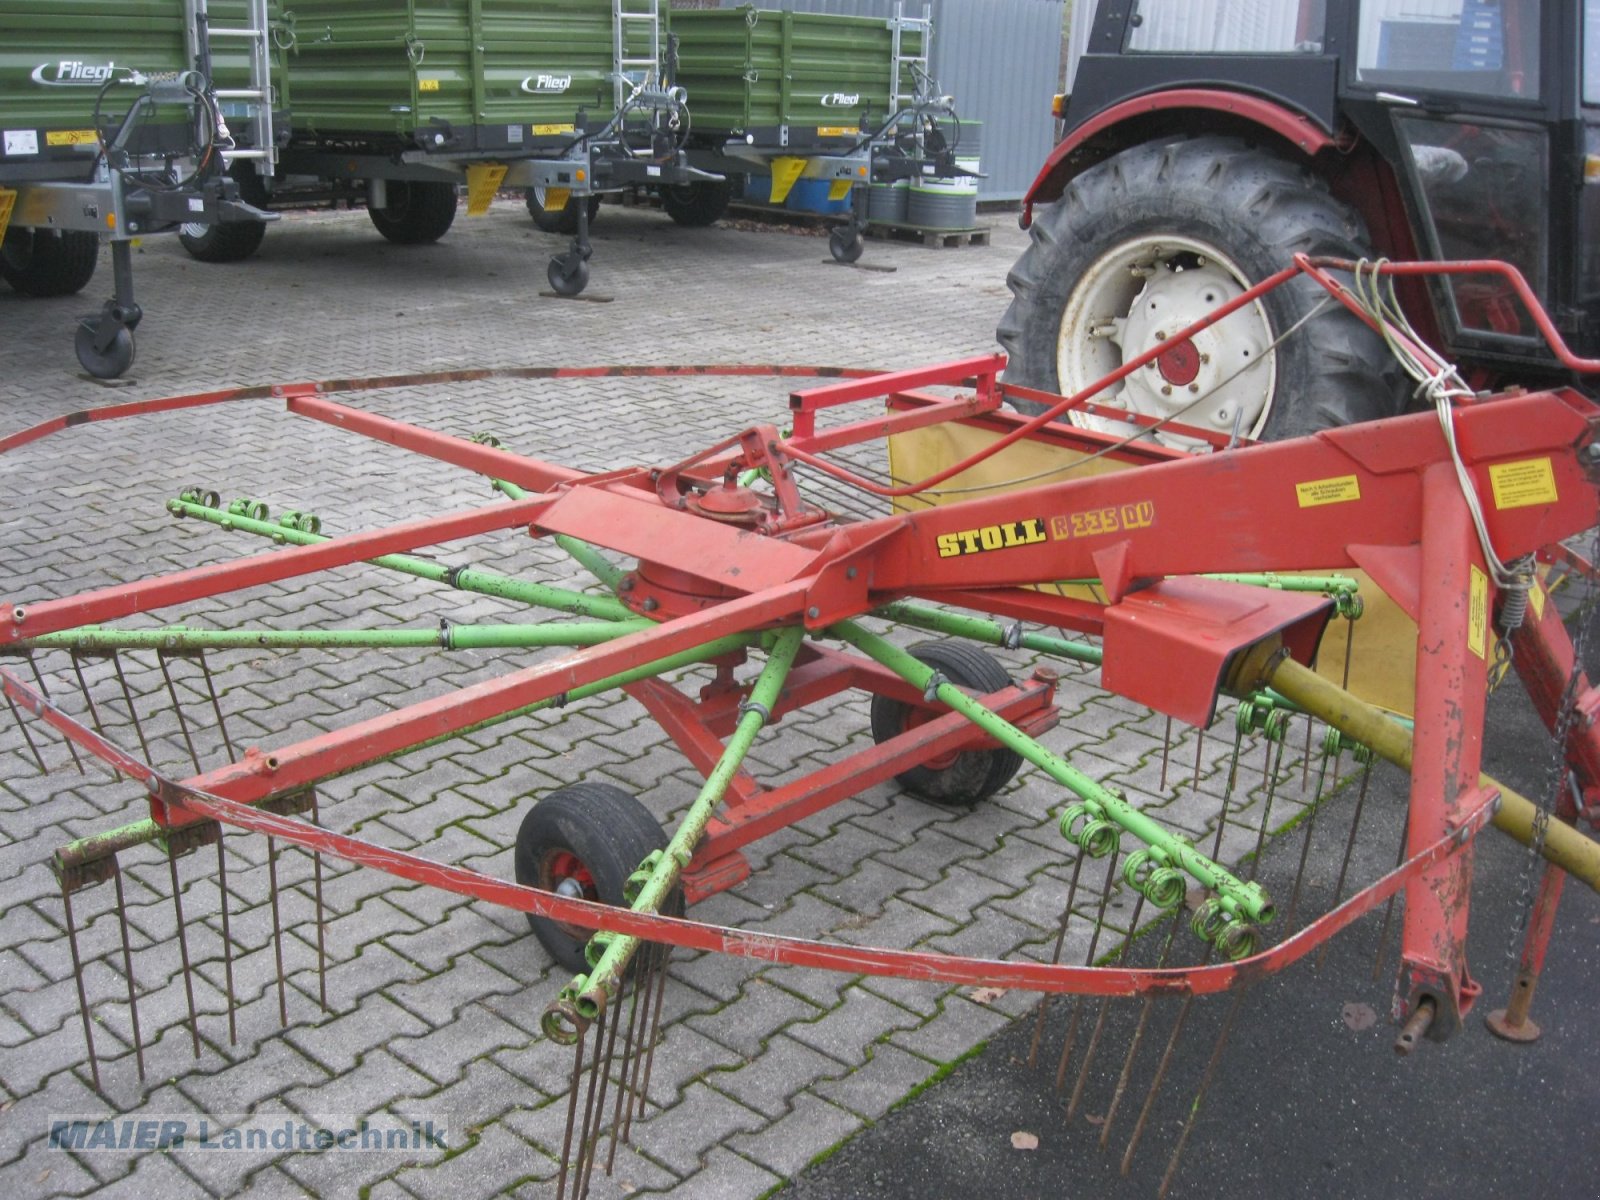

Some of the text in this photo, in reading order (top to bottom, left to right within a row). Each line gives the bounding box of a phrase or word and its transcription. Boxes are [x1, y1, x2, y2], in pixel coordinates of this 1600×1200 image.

[57, 61, 114, 80] Fliegl
[536, 75, 572, 90] Fliegl
[937, 518, 1047, 558] STOLL
[1051, 516, 1069, 541] R
[1071, 508, 1119, 537] 335
